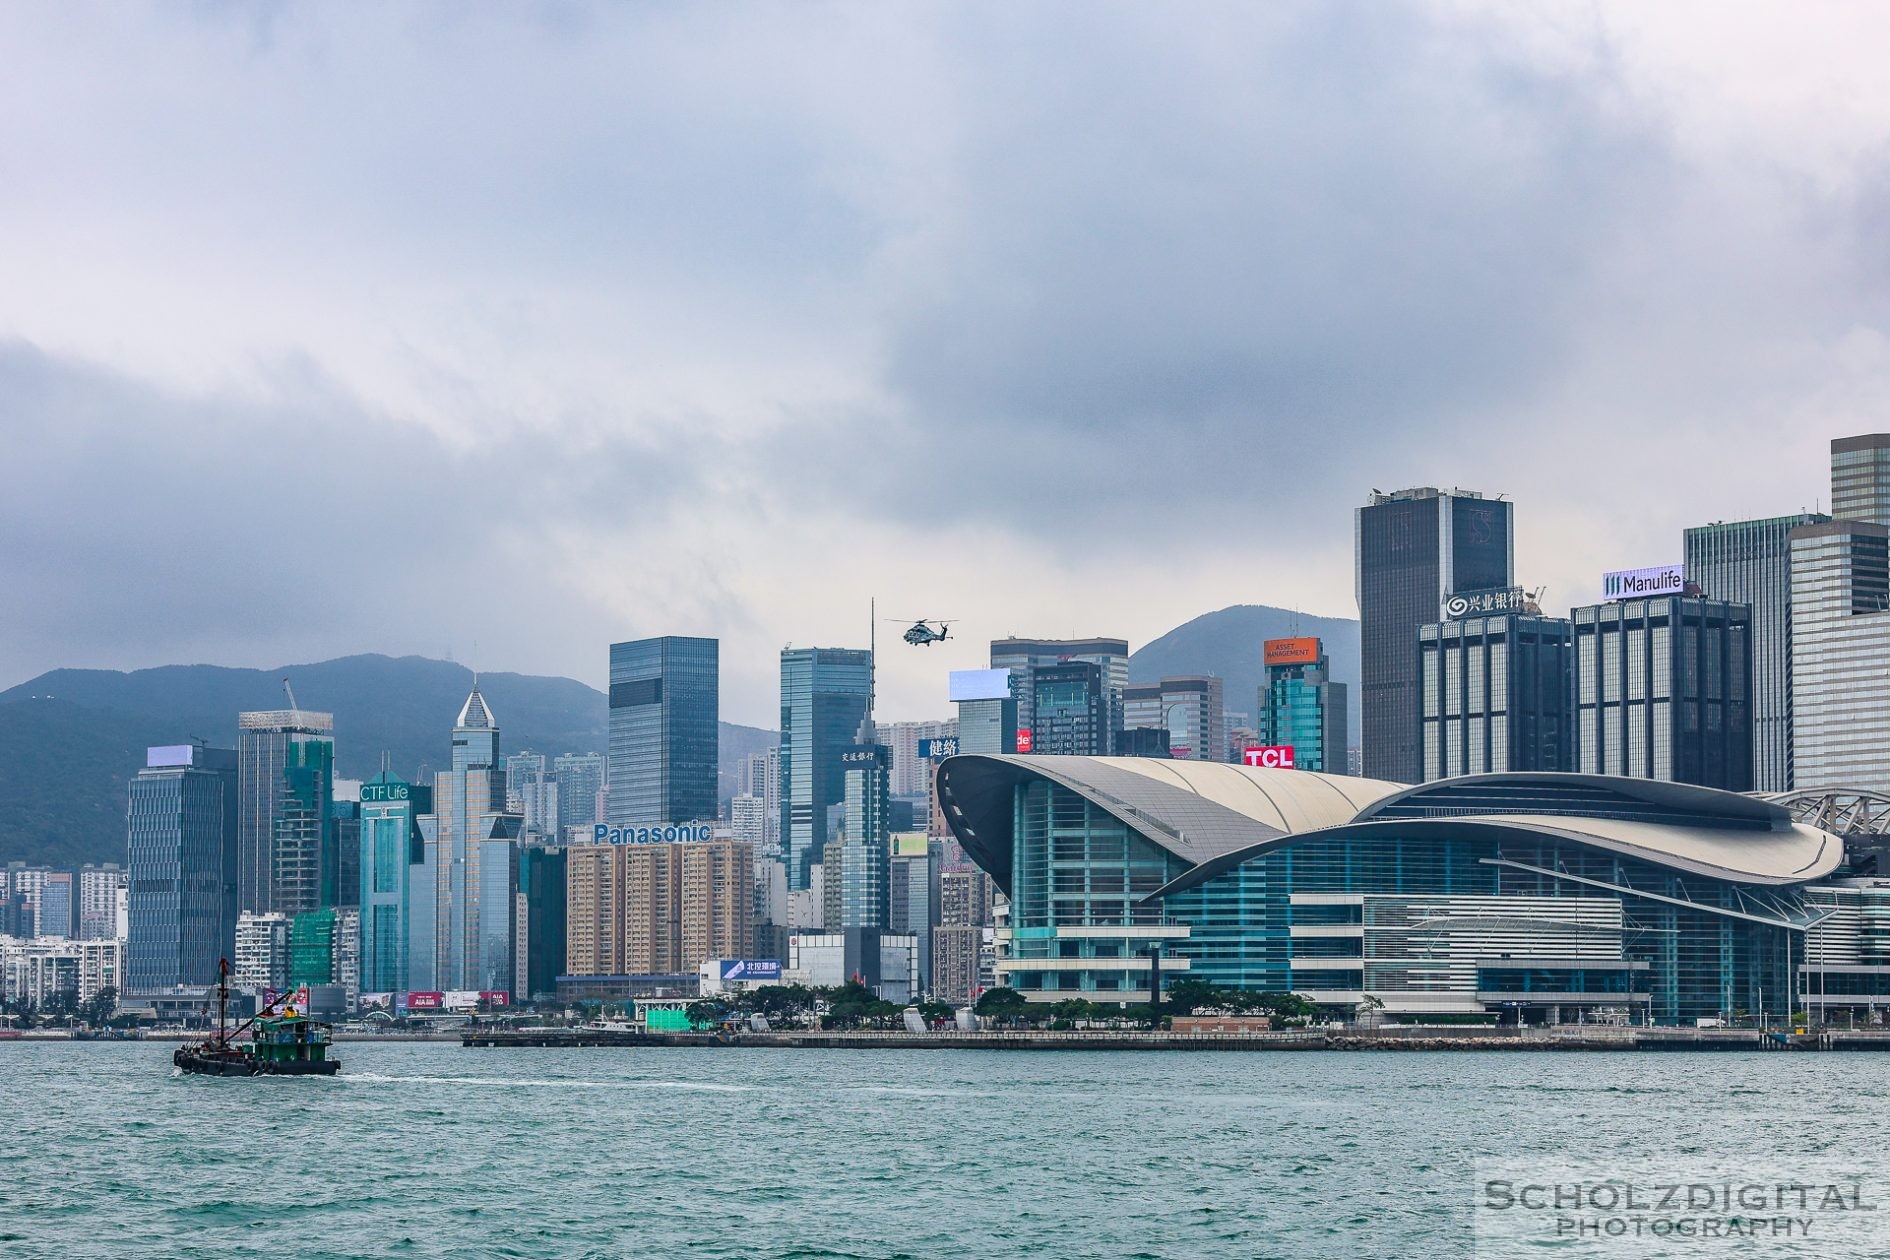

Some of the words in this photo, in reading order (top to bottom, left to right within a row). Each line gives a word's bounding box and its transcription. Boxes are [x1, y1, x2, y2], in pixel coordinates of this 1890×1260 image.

[1623, 570, 1681, 593] Manulife
[1468, 591, 1521, 612] 兴业银行
[1266, 649, 1309, 658] MANAGEMENT
[929, 739, 960, 757] 健絡
[1017, 734, 1031, 745] de
[1246, 749, 1293, 768] TCL
[360, 785, 385, 801] CTF
[387, 784, 408, 800] Life
[594, 819, 712, 845] Panasonic
